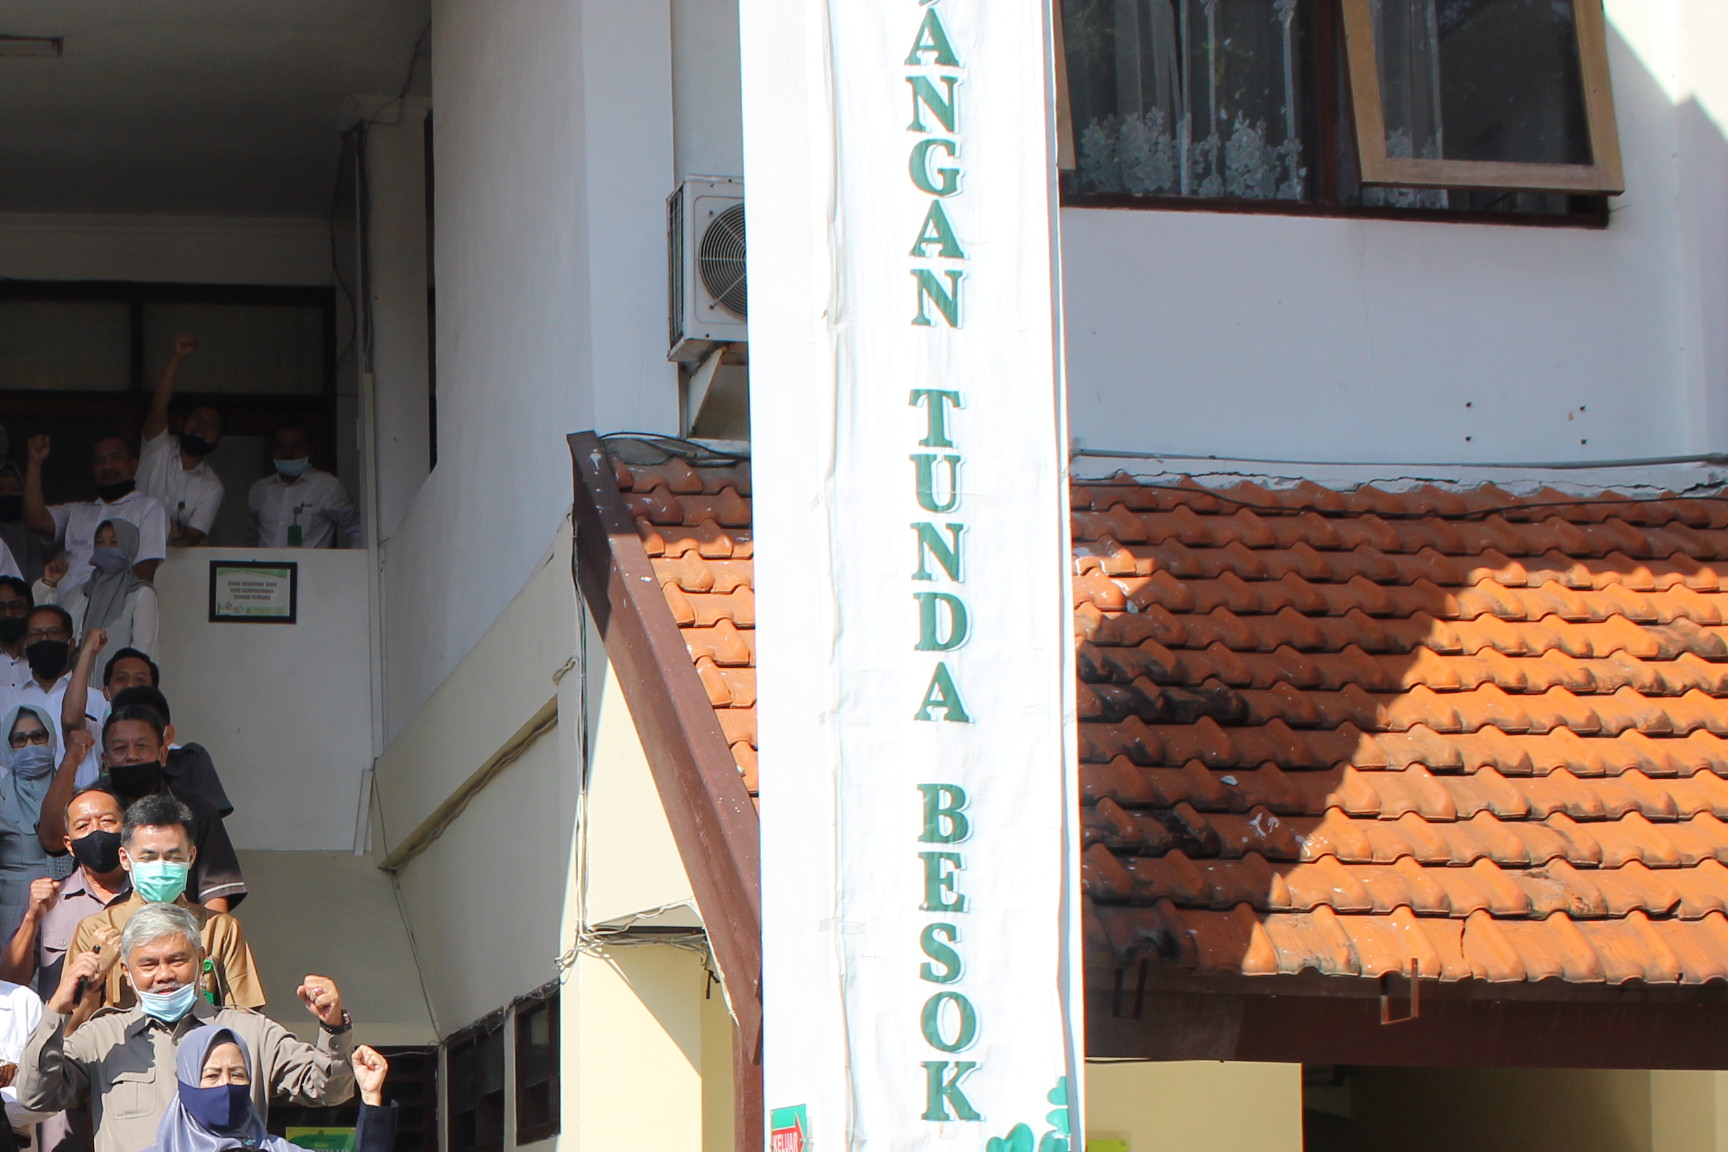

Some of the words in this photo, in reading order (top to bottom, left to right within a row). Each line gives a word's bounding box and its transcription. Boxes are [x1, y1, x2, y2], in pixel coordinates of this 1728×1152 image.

[904, 0, 964, 329] ANGAN
[907, 388, 973, 724] TUNDA
[916, 783, 982, 1122] BESOK
